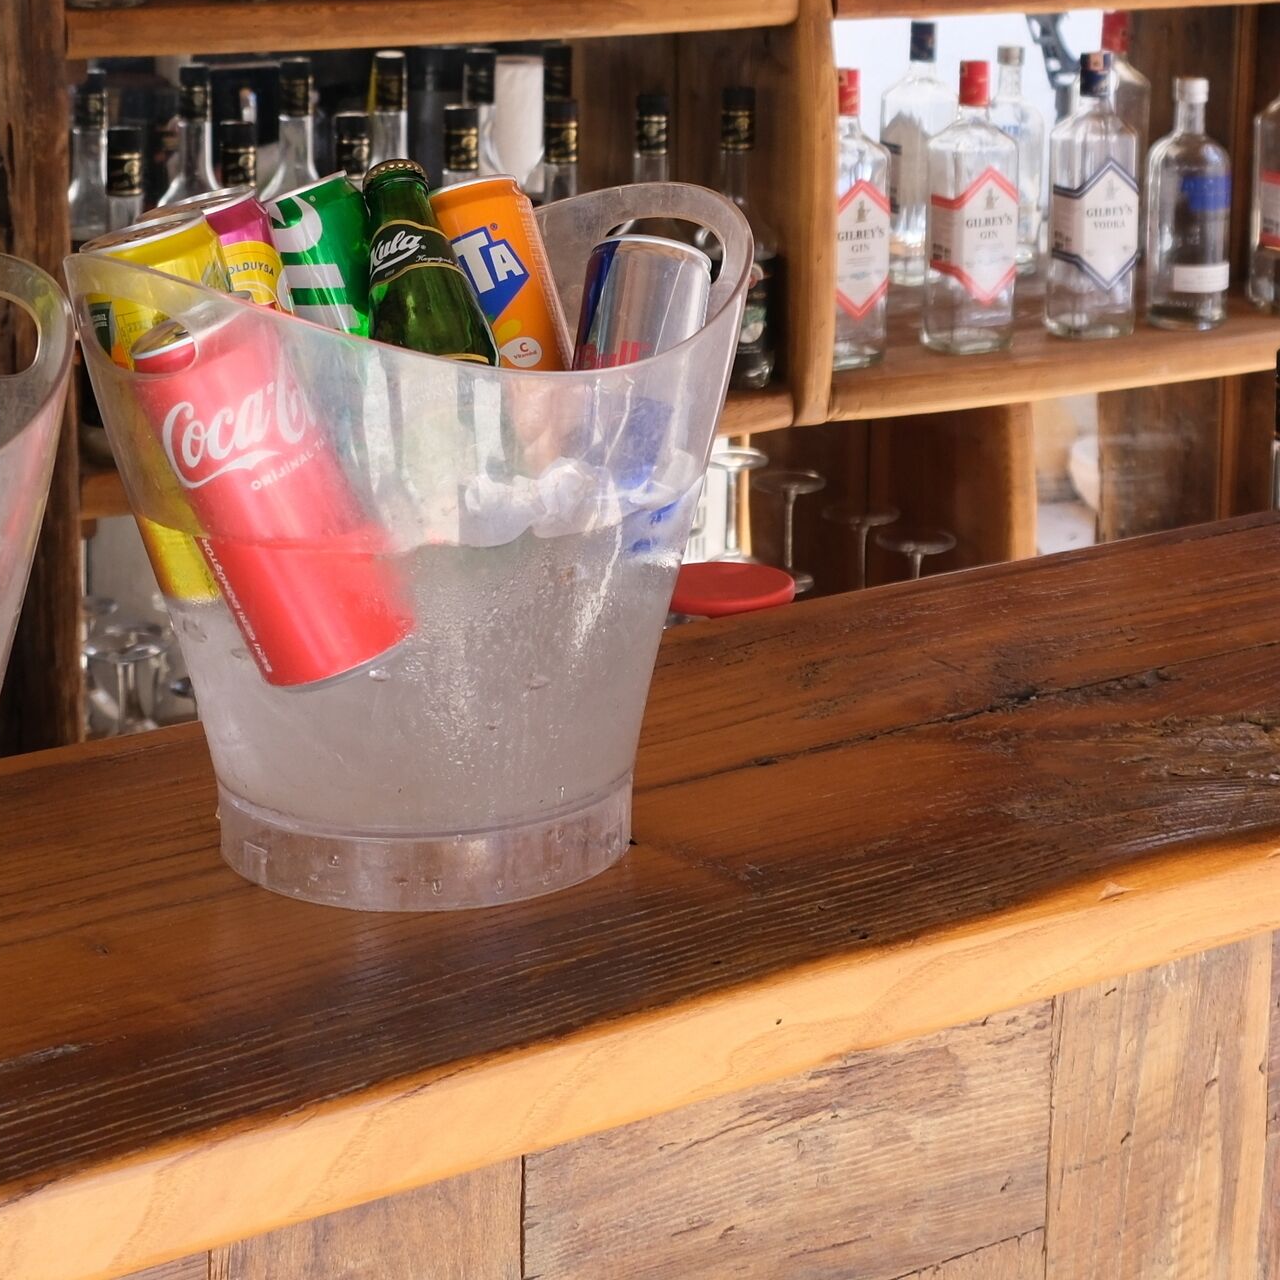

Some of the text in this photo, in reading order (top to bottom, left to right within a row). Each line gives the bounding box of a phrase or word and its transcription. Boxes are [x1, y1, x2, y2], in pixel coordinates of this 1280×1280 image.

[979, 231, 998, 240] GIN
[851, 243, 870, 253] GIN
[519, 341, 529, 352] C
